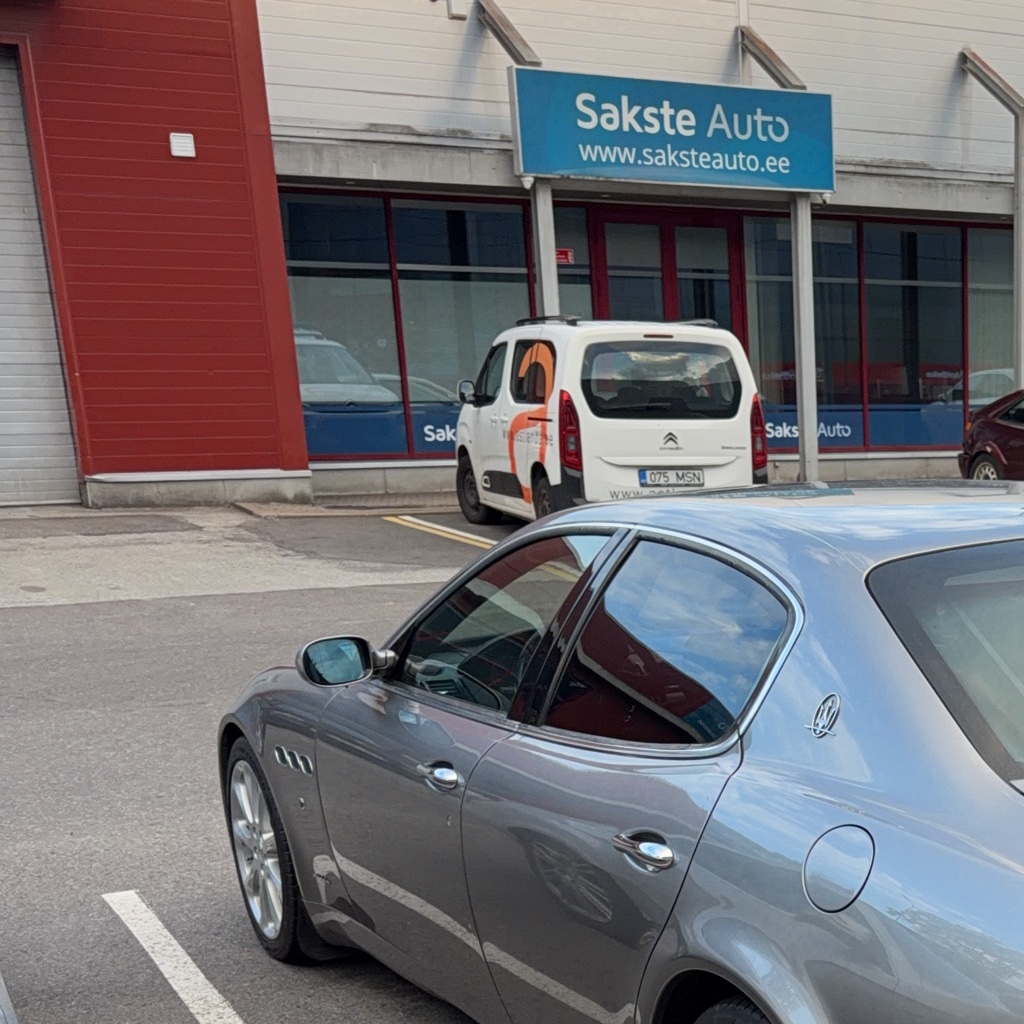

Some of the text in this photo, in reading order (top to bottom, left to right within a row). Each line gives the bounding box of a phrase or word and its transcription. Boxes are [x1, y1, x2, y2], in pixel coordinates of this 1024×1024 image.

[575, 92, 790, 143] Sakste Auto
[578, 143, 791, 174] www.saksteauto.ee
[817, 422, 852, 438] Auto
[649, 471, 701, 483] 075 MSN
